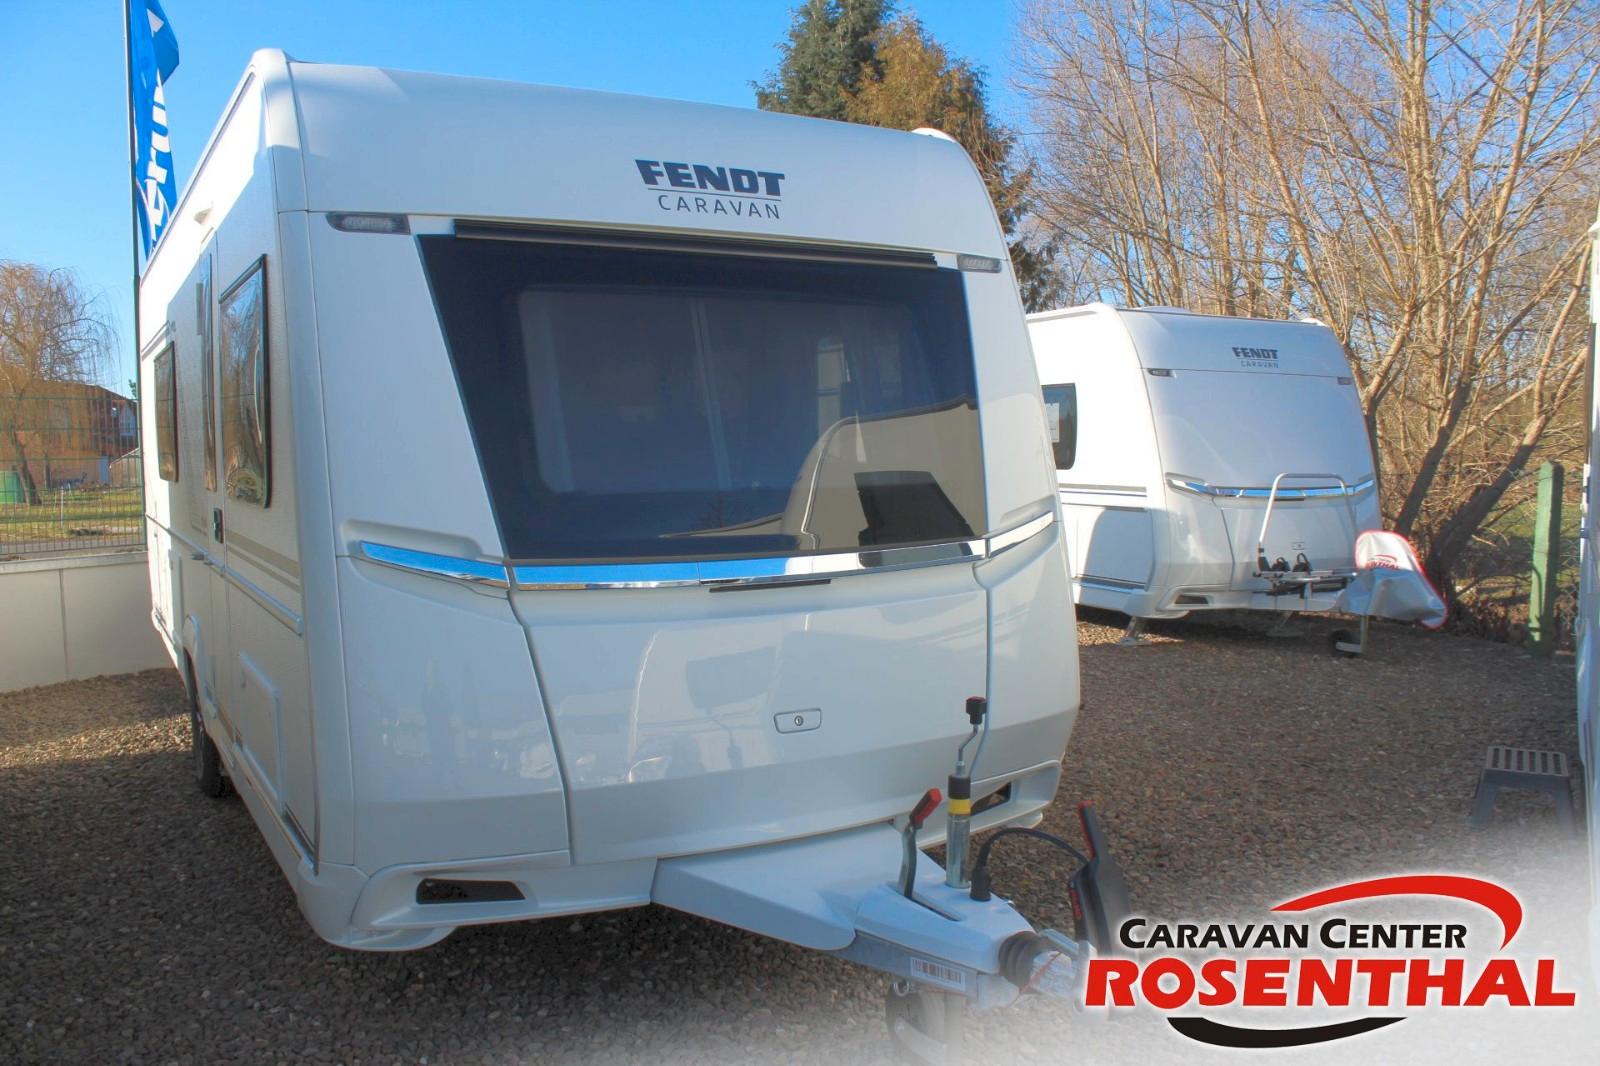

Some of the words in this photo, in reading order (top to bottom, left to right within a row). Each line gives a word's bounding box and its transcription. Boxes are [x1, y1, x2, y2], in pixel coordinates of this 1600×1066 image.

[635, 159, 785, 196] FENDT
[658, 194, 780, 219] CARAVAN
[1232, 347, 1278, 359] FENDT
